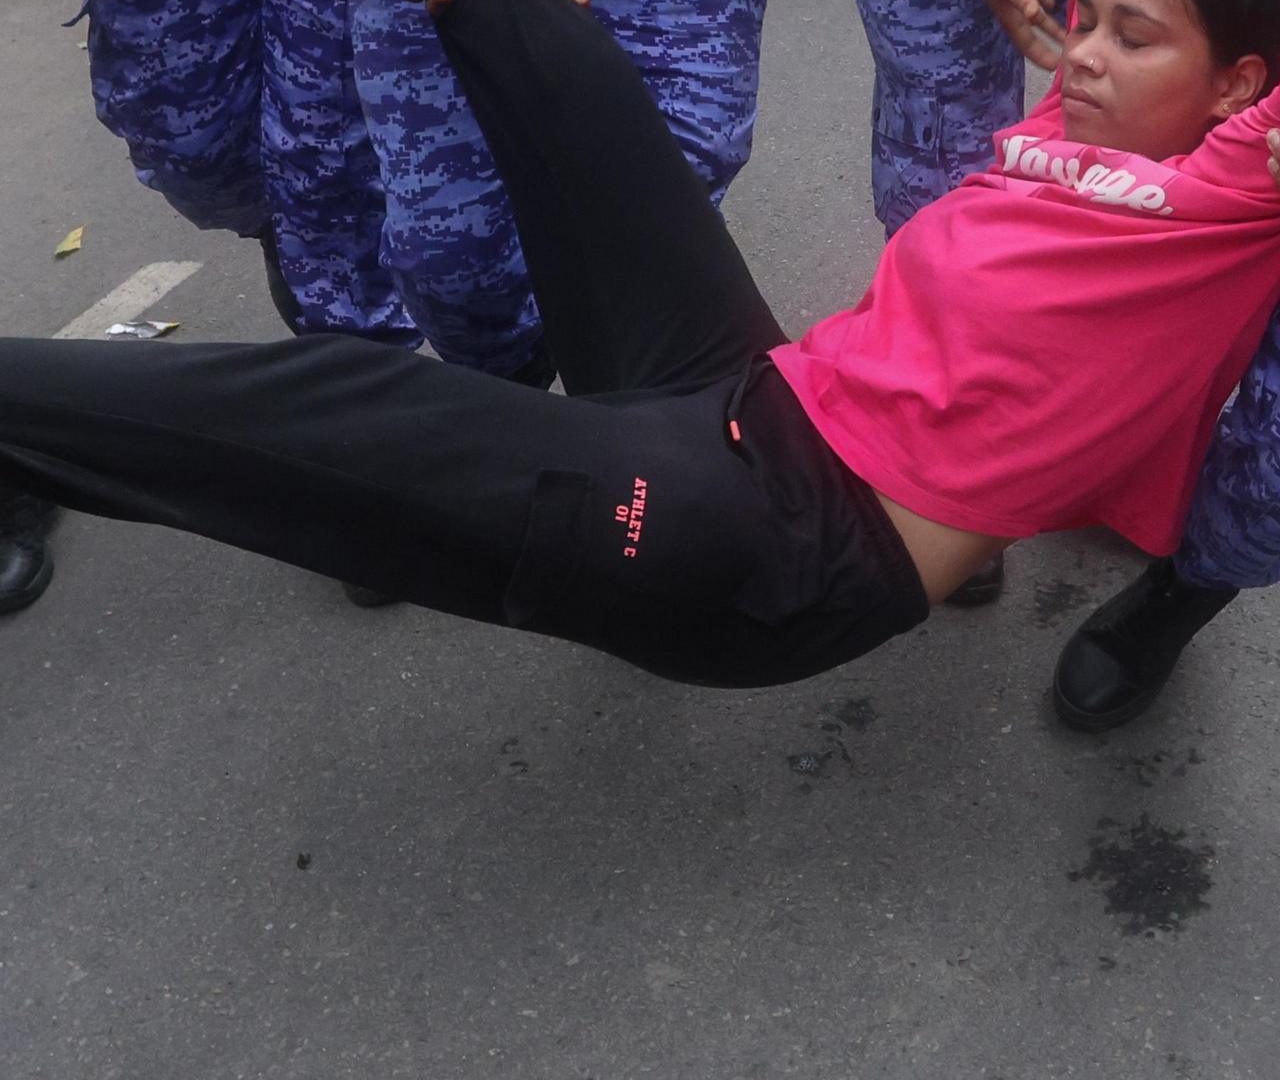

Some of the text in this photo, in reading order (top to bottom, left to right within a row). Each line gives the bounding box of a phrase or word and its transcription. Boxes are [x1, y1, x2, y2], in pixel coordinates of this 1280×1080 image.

[615, 505, 629, 522] 01
[624, 478, 647, 557] ATHLET C
